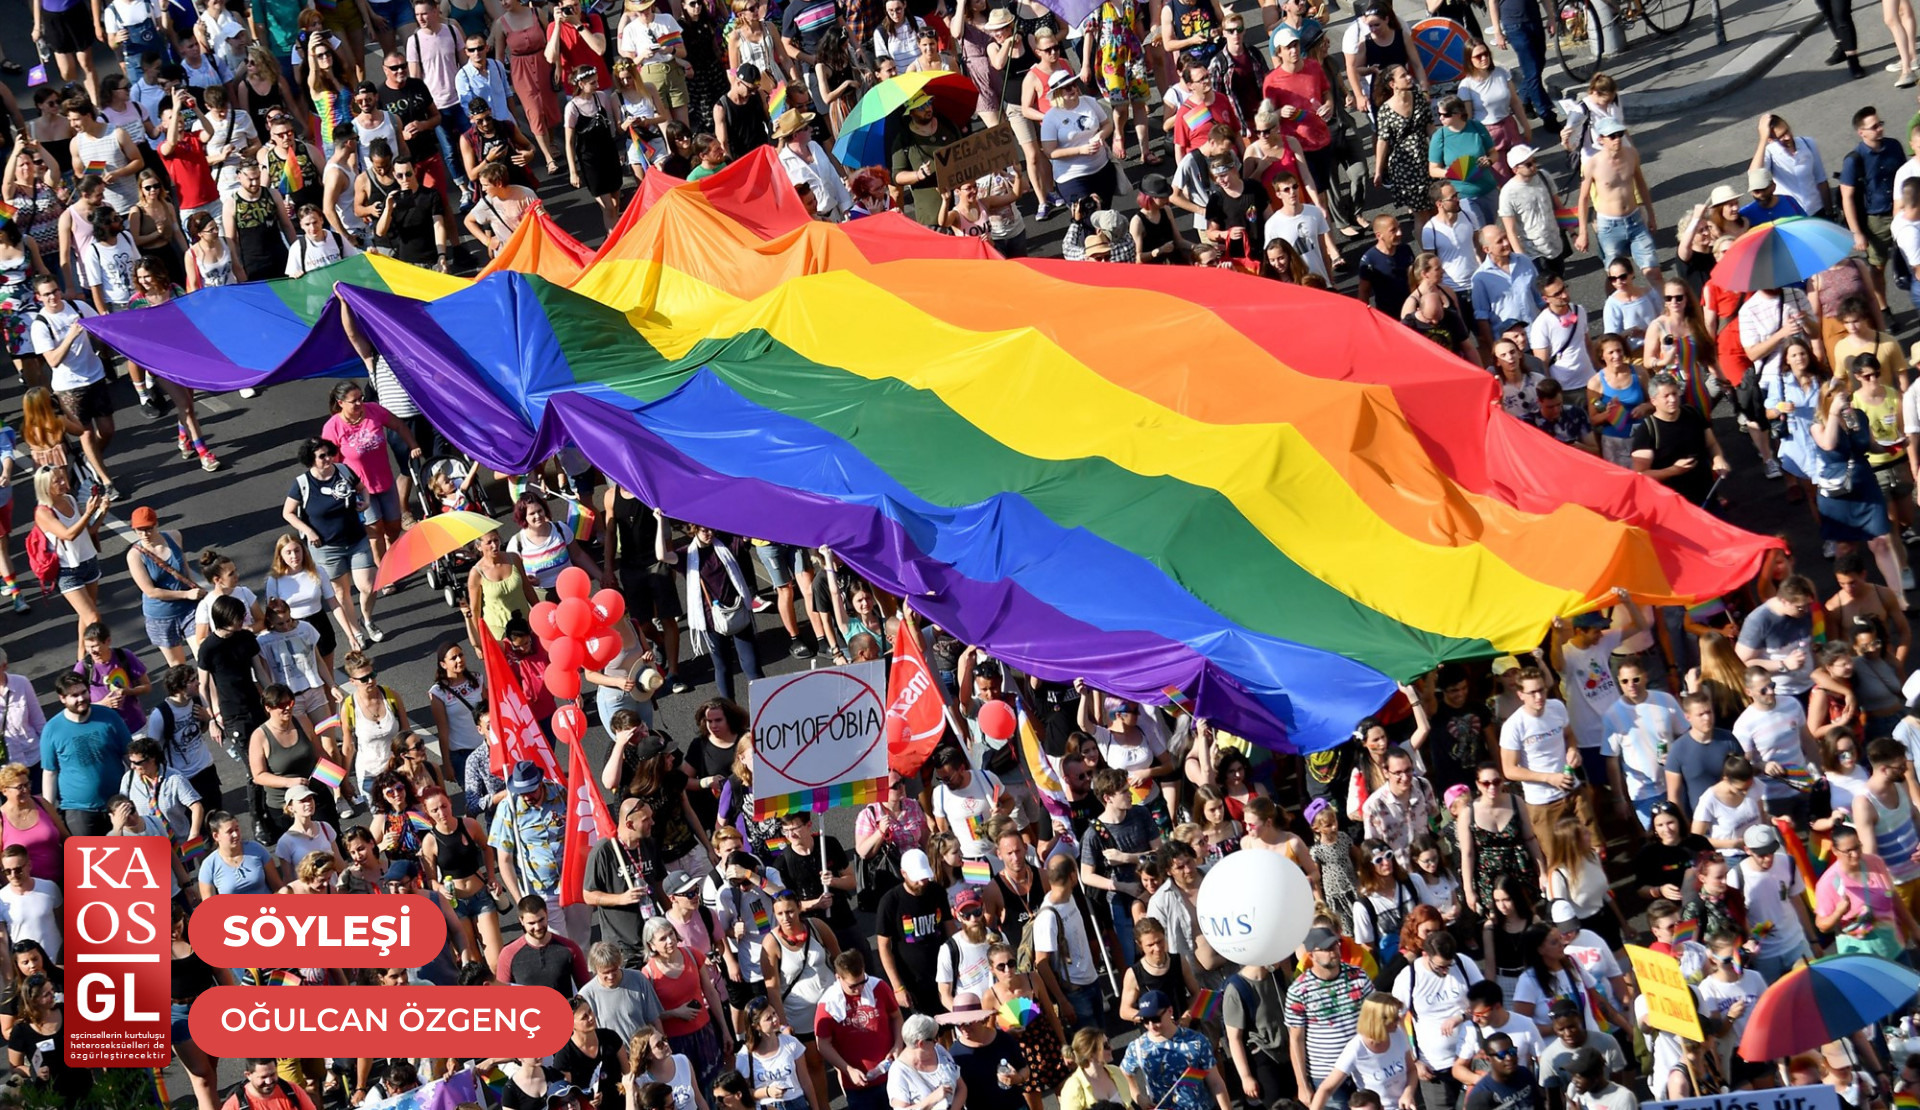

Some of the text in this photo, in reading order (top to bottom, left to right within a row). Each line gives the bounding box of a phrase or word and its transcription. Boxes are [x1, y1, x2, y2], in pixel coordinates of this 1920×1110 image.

[935, 127, 1012, 167] VEGANS
[947, 152, 1010, 187] EQUALITY
[753, 706, 881, 754] HOMOFÓBIA
[913, 913, 936, 937] LOVE
